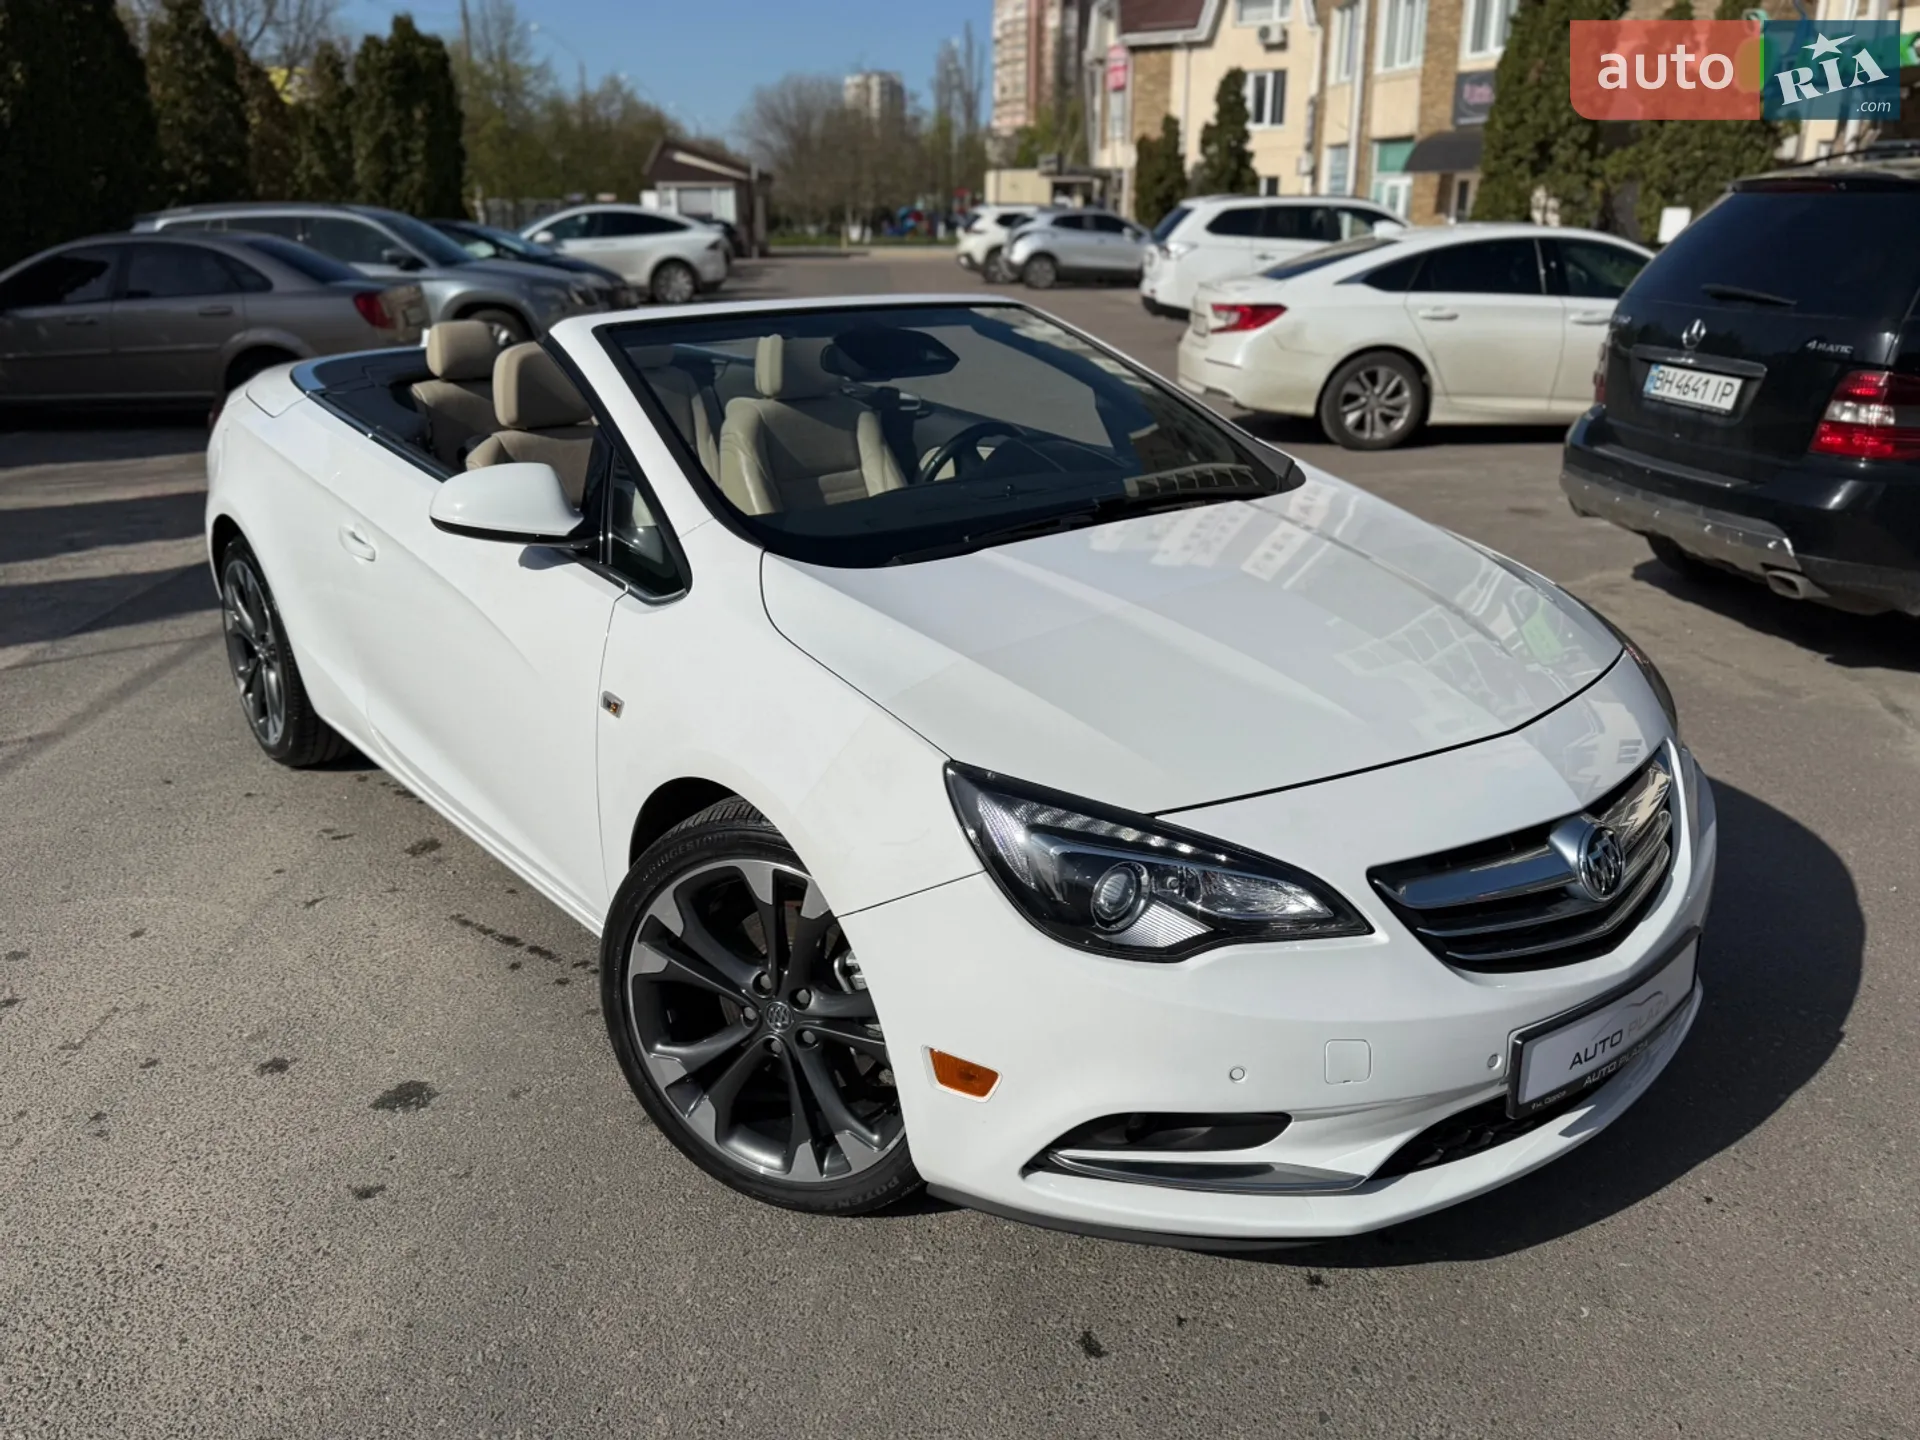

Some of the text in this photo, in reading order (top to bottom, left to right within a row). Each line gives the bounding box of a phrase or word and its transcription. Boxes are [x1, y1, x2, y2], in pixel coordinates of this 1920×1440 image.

[1711, 381, 1736, 405] IP
[1568, 1028, 1624, 1071] AUTO
[1583, 1061, 1617, 1088] AUTO
